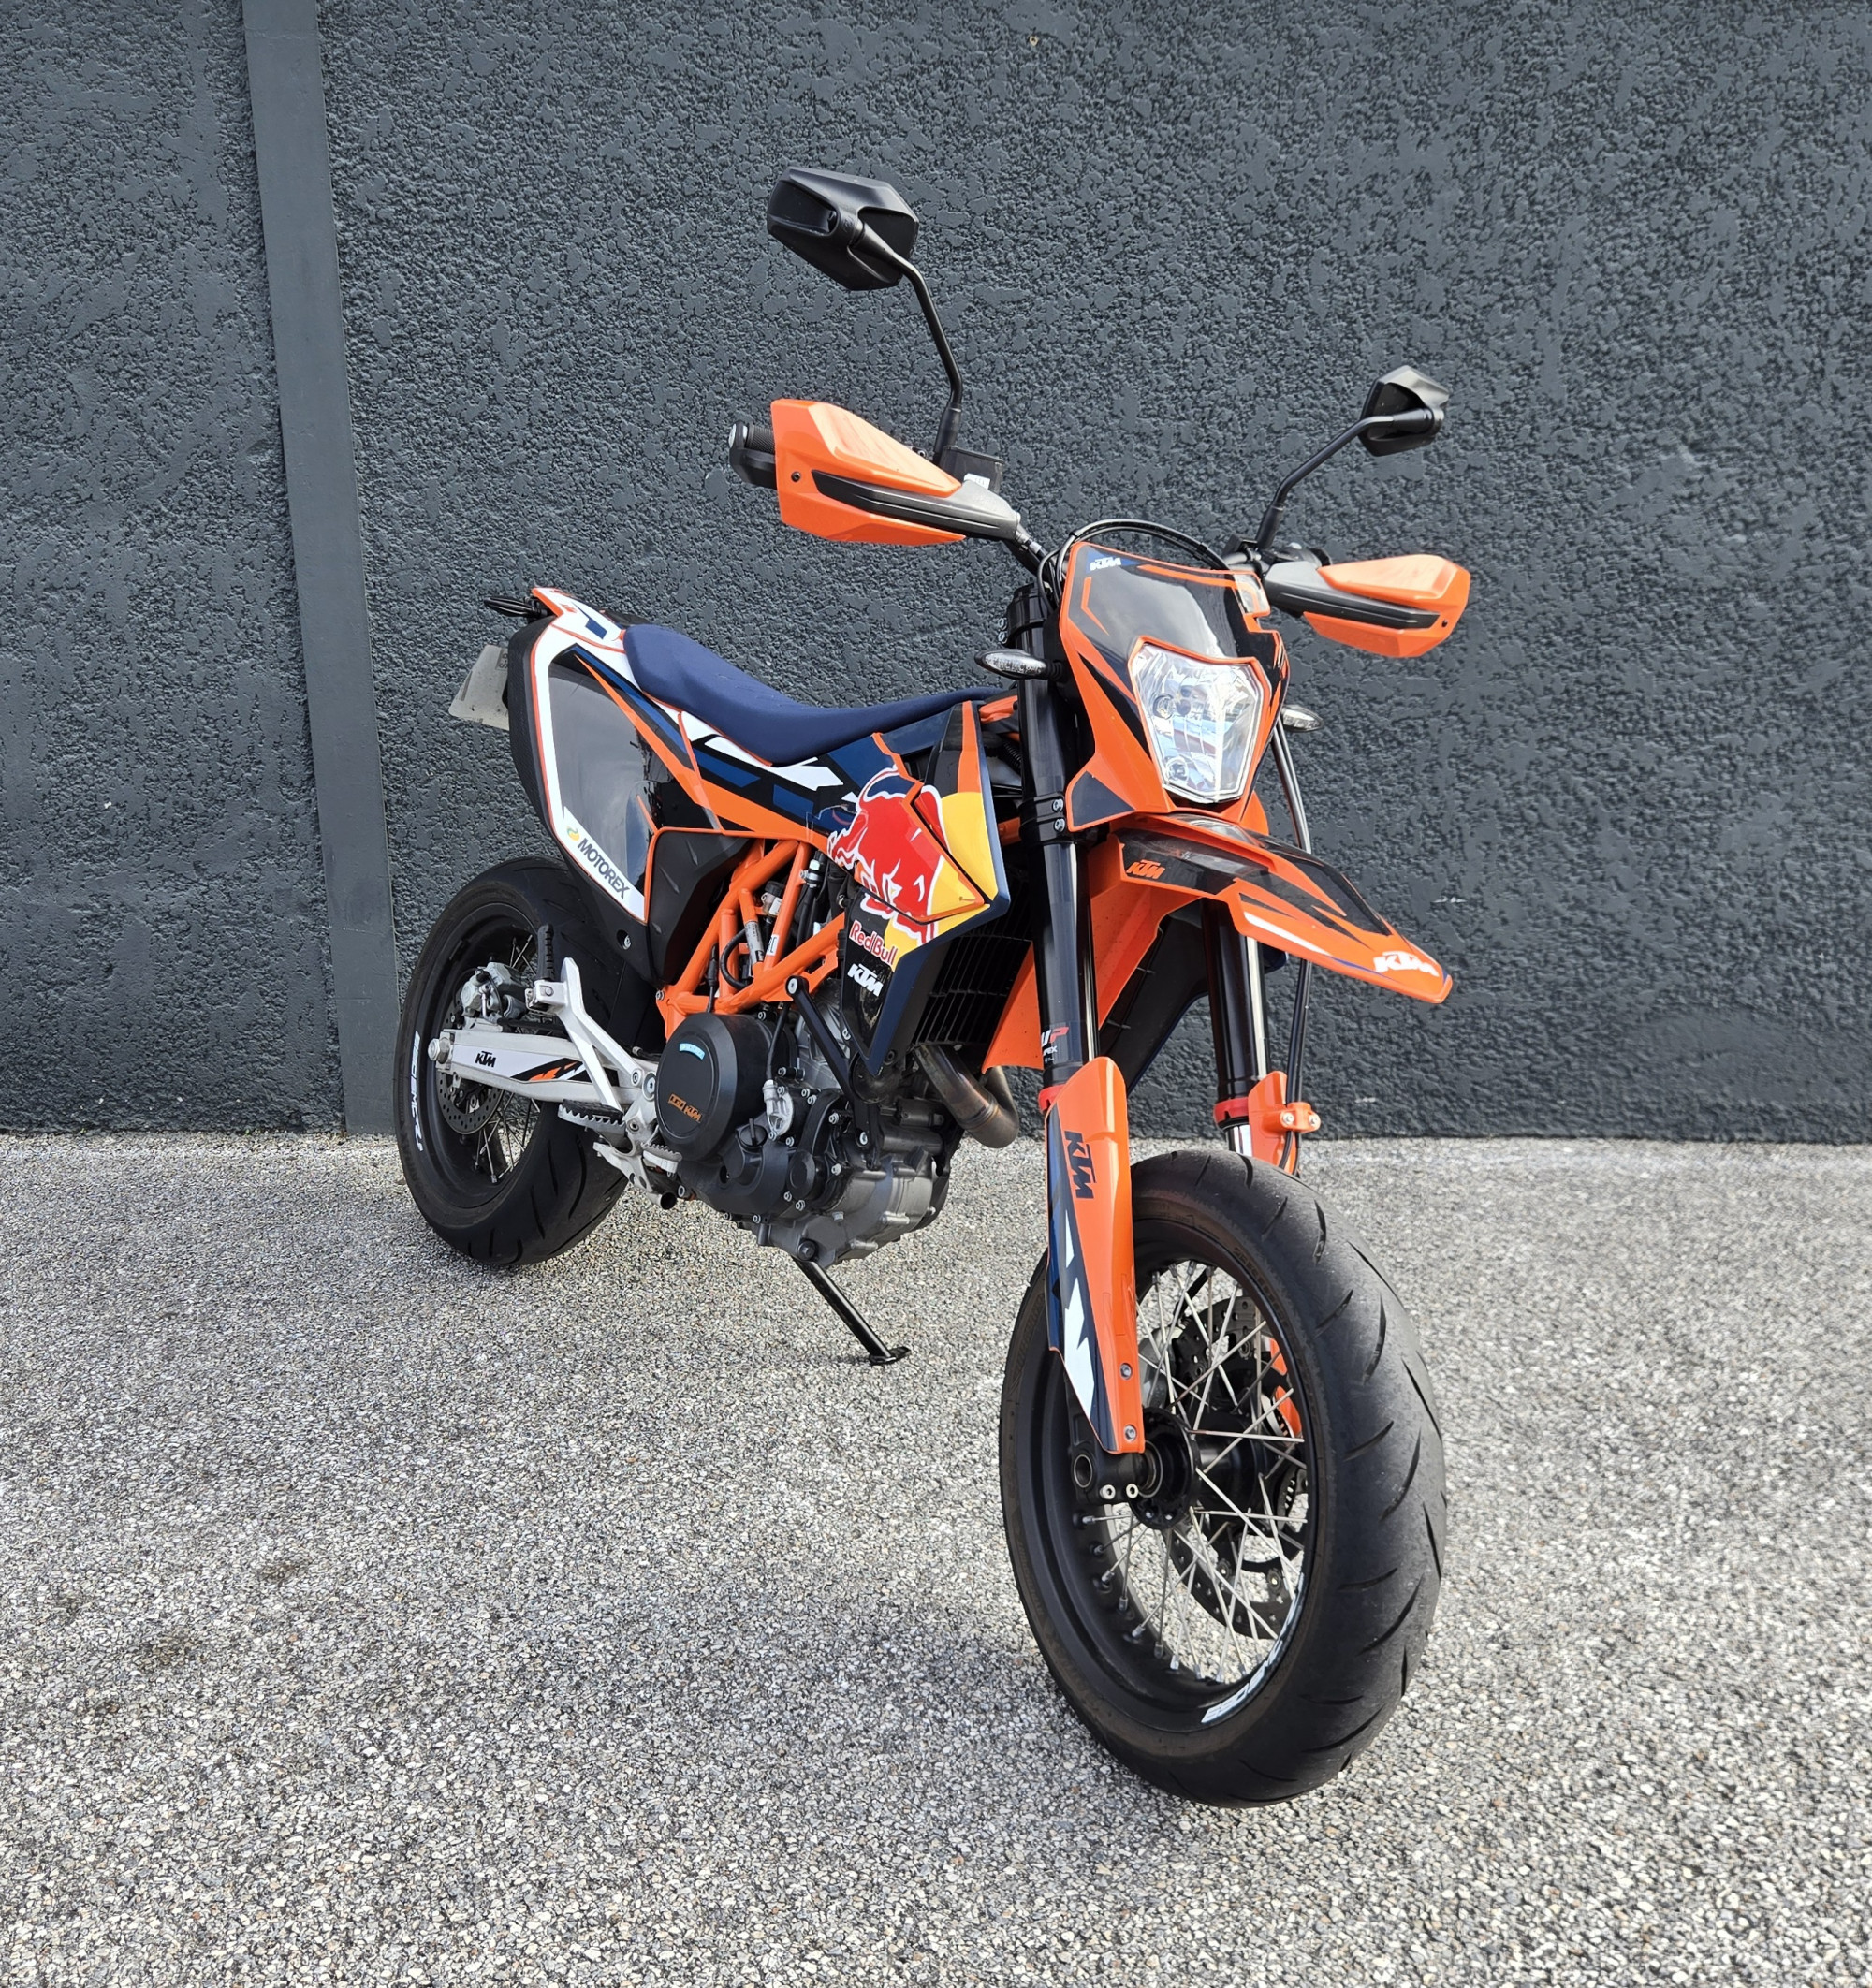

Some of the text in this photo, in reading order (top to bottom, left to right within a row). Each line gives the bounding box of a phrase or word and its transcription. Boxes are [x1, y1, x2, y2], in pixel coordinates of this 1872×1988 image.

[1090, 557, 1122, 571] KTM
[578, 838, 631, 899] MOTOREX
[1126, 859, 1165, 880] KTM
[1372, 951, 1440, 978] KTM
[847, 963, 884, 997] KTM
[475, 1050, 497, 1068] KTM
[1064, 1130, 1097, 1199] KTM
